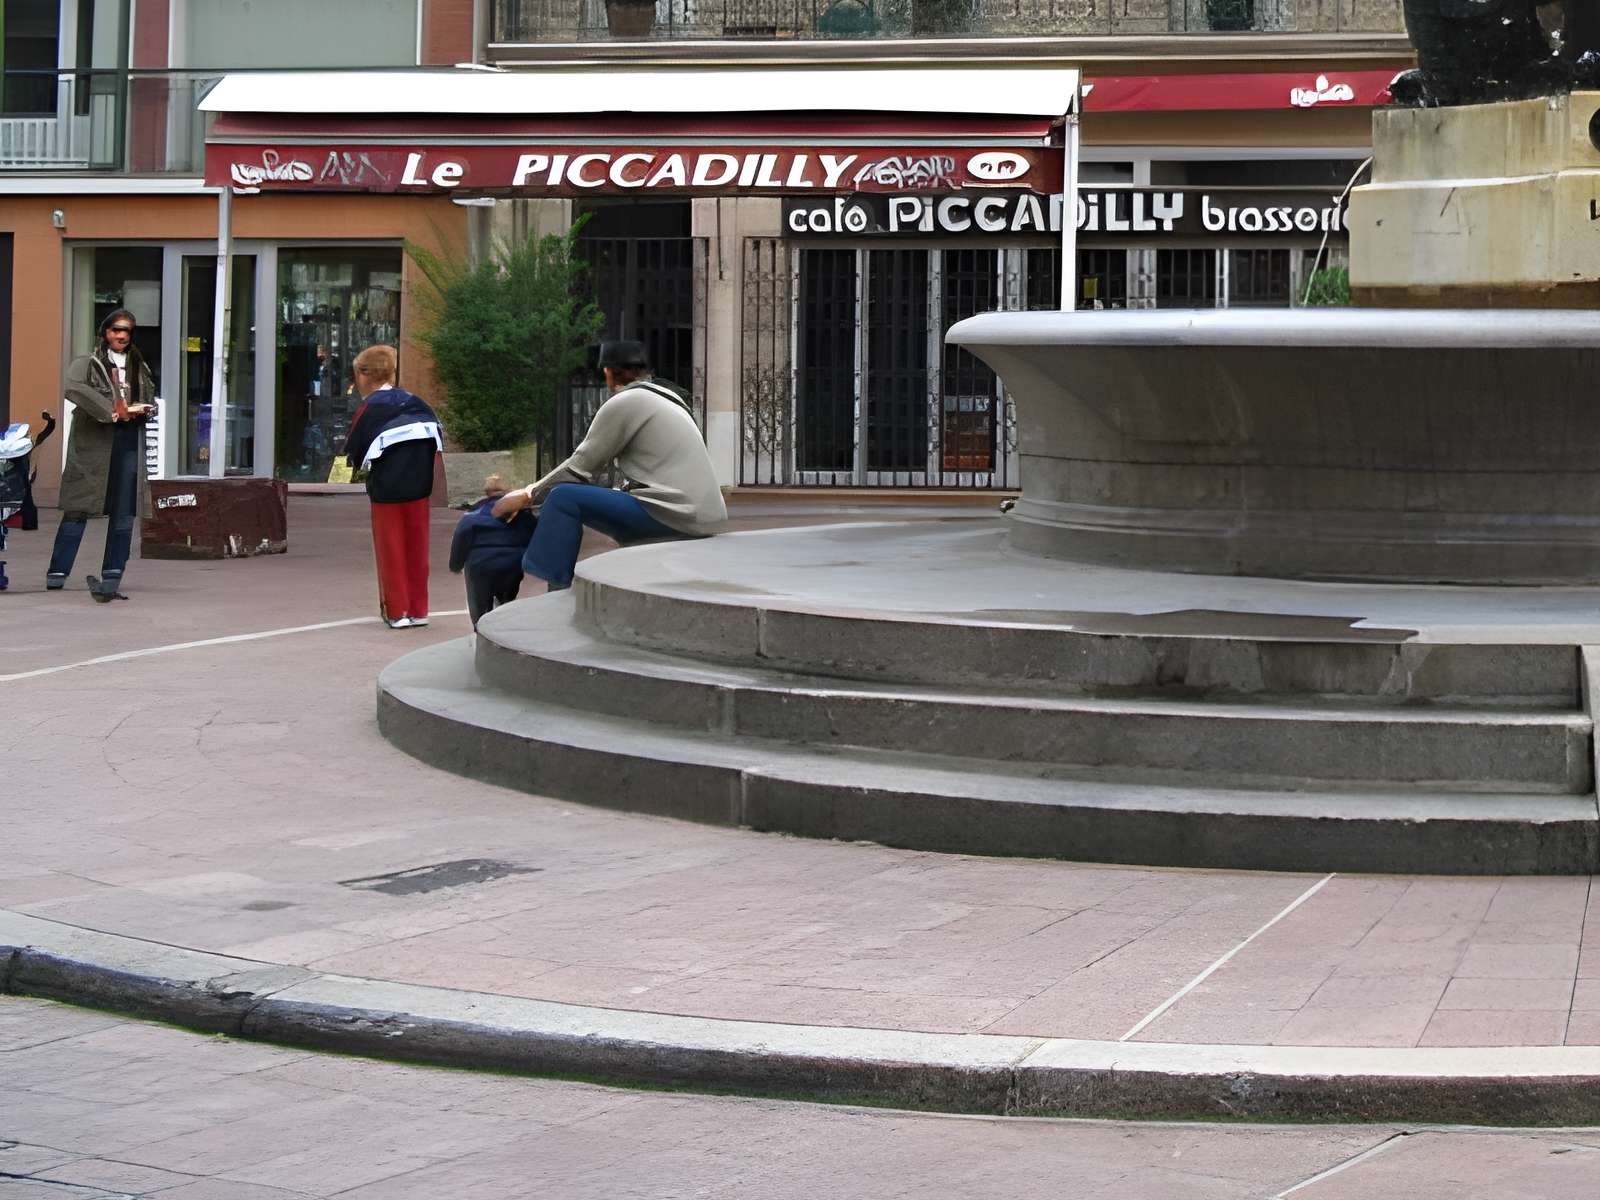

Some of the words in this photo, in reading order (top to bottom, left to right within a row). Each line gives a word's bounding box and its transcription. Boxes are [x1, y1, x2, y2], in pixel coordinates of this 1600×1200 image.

[401, 153, 464, 187] Le
[512, 153, 858, 188] PICCADILLY
[1202, 195, 1350, 231] brasseri
